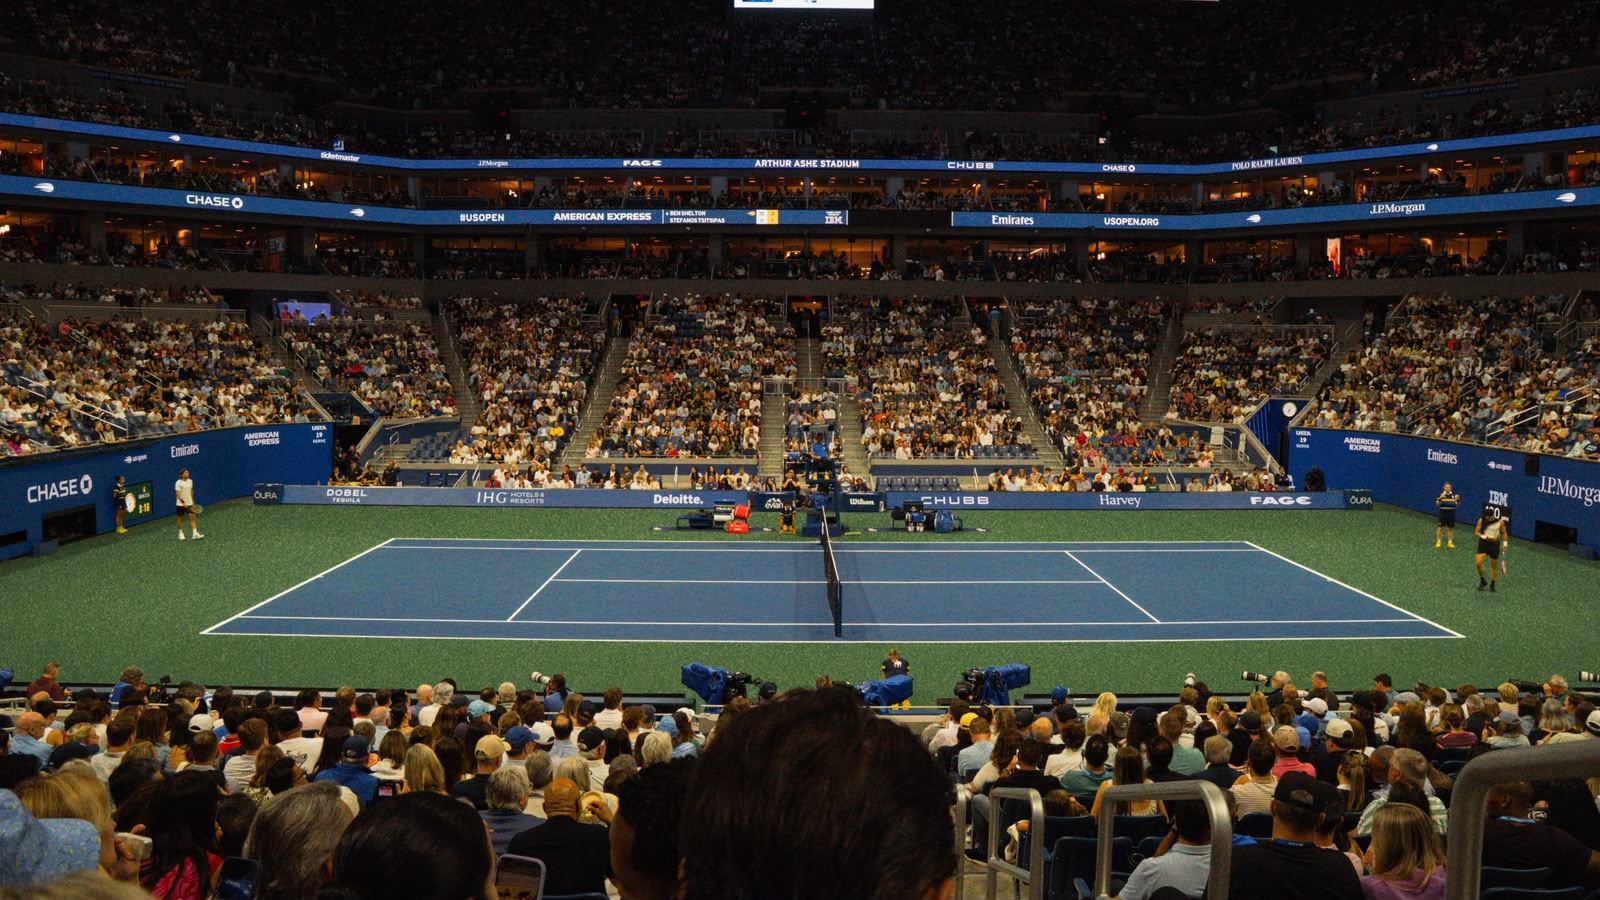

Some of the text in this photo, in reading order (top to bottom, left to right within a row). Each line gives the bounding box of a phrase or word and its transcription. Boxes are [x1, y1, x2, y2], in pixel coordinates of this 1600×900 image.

[321, 151, 360, 162] ticketmaster
[478, 160, 509, 168] J.P.Morgan
[755, 160, 860, 168] ARTHUR ASHE STADIUM
[1231, 157, 1303, 171] POLO RALPH LAUREN
[186, 195, 230, 208] CHASE
[1369, 202, 1426, 216] J.P.Morgan
[460, 213, 505, 222] #USOPEN
[553, 213, 652, 222] AMERICAN EXPRESS
[825, 216, 843, 224] IBM
[991, 214, 1034, 226] Emirates
[1104, 217, 1159, 226] USOPEN.ORG
[244, 431, 279, 440] AMERICAN
[248, 438, 280, 446] EXPRESS
[1344, 436, 1380, 446] AMERICAN
[171, 444, 200, 458] Emirates
[1349, 443, 1381, 453] EXPRESS
[1427, 448, 1458, 465] Emirates
[27, 478, 79, 504] CHASE
[326, 489, 367, 497] DOBEL
[1537, 475, 1600, 507] J.P.Morga
[477, 491, 507, 504] IHG
[653, 494, 704, 505] Deloitte.
[850, 498, 875, 506] Wilson
[921, 496, 990, 505] CHUBB
[1099, 494, 1141, 508] Harvey
[1489, 490, 1509, 507] IBM
[765, 500, 784, 509] evian
